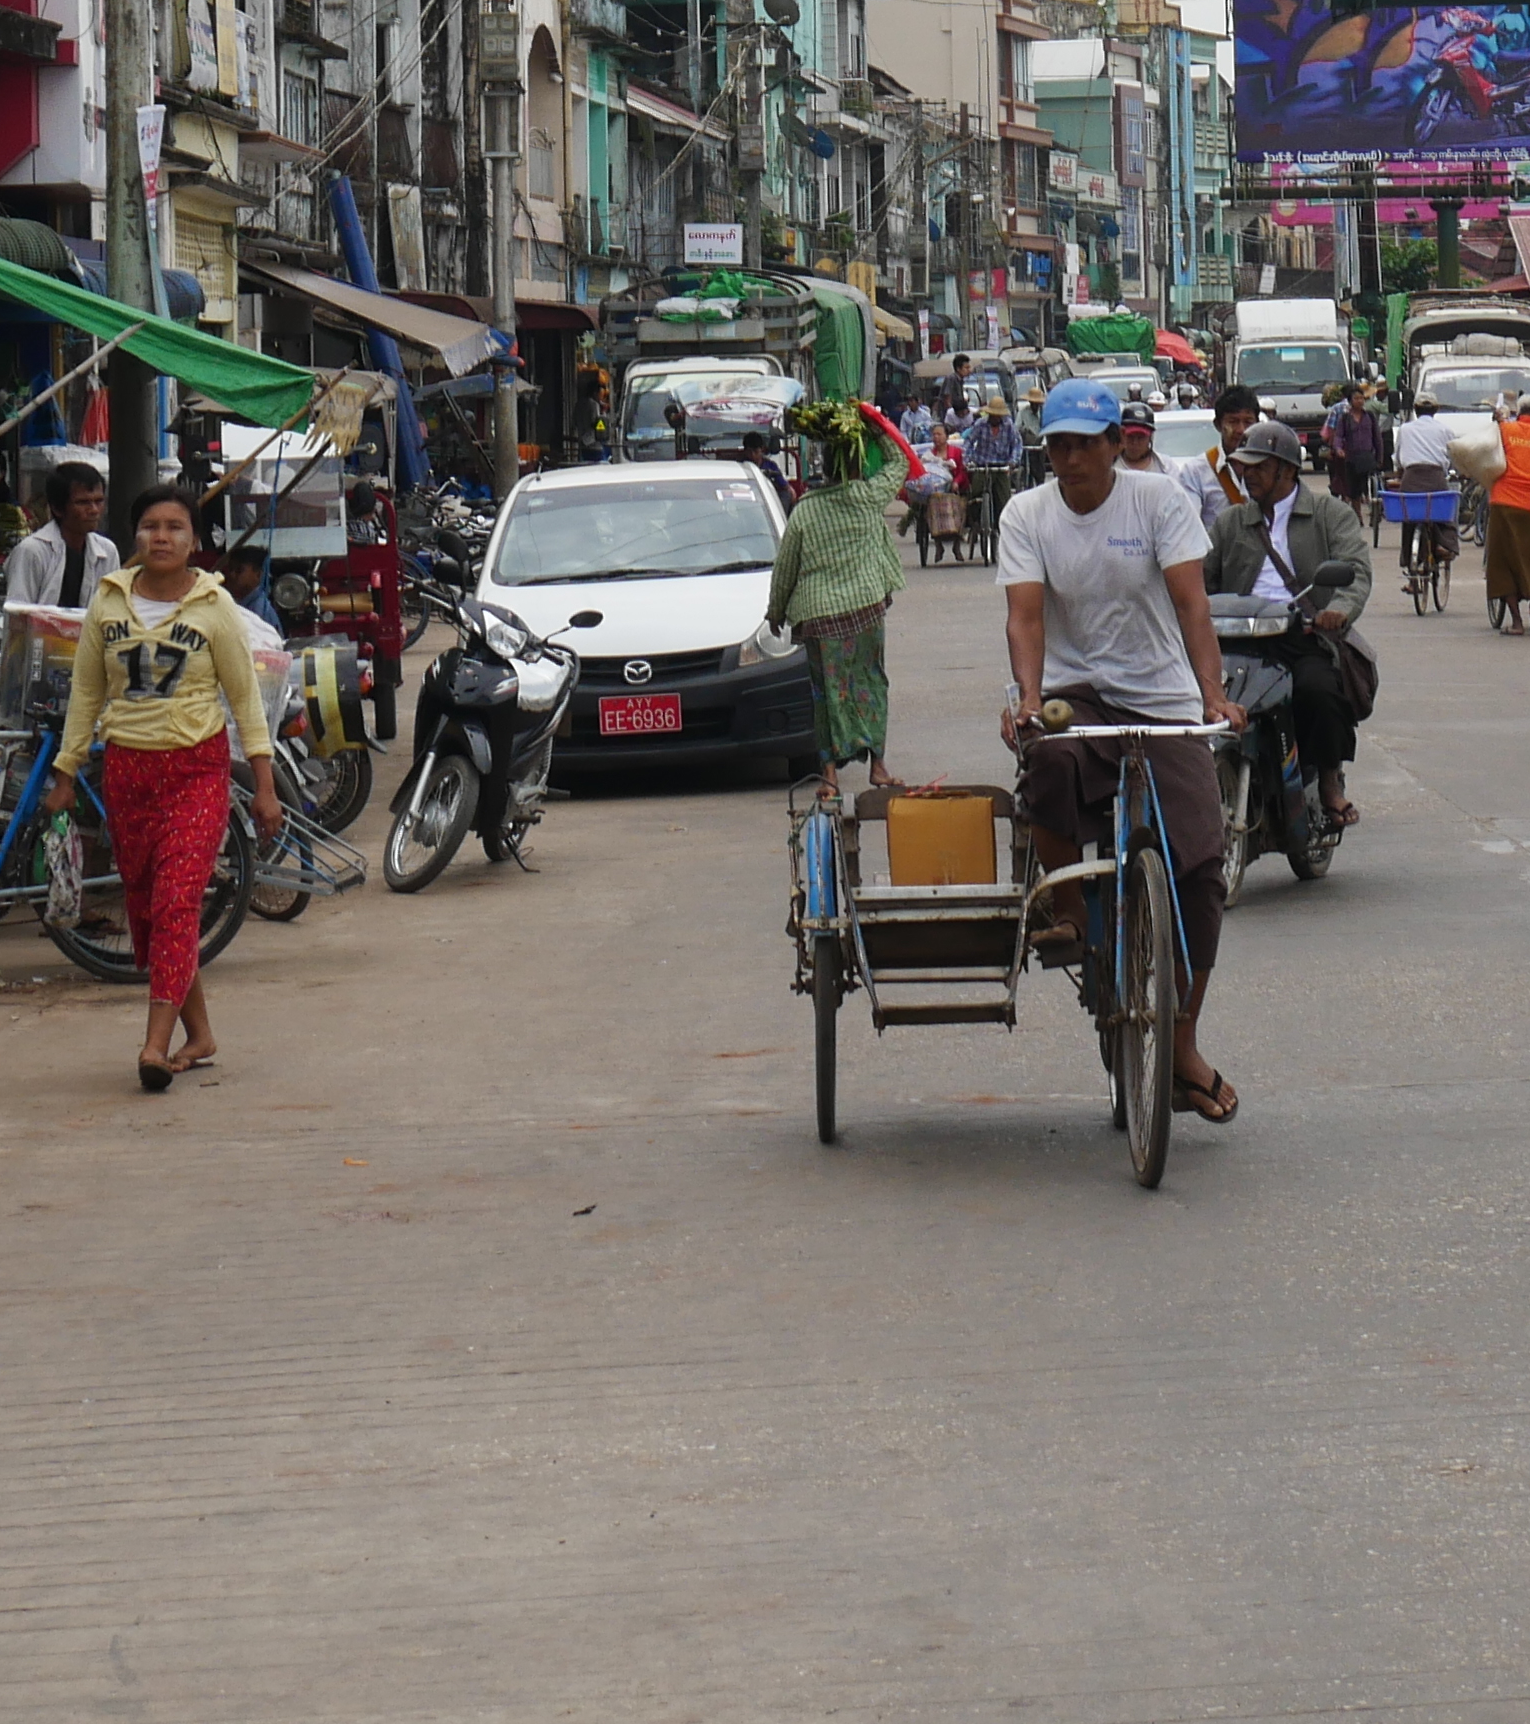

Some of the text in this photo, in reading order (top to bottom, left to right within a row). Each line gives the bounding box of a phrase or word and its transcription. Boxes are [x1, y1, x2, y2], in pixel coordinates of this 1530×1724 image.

[1106, 535, 1143, 547] Smooth
[170, 622, 207, 652] WAY
[117, 642, 188, 700] 17
[627, 698, 652, 709] AYY
[605, 707, 675, 732] EE-6936
